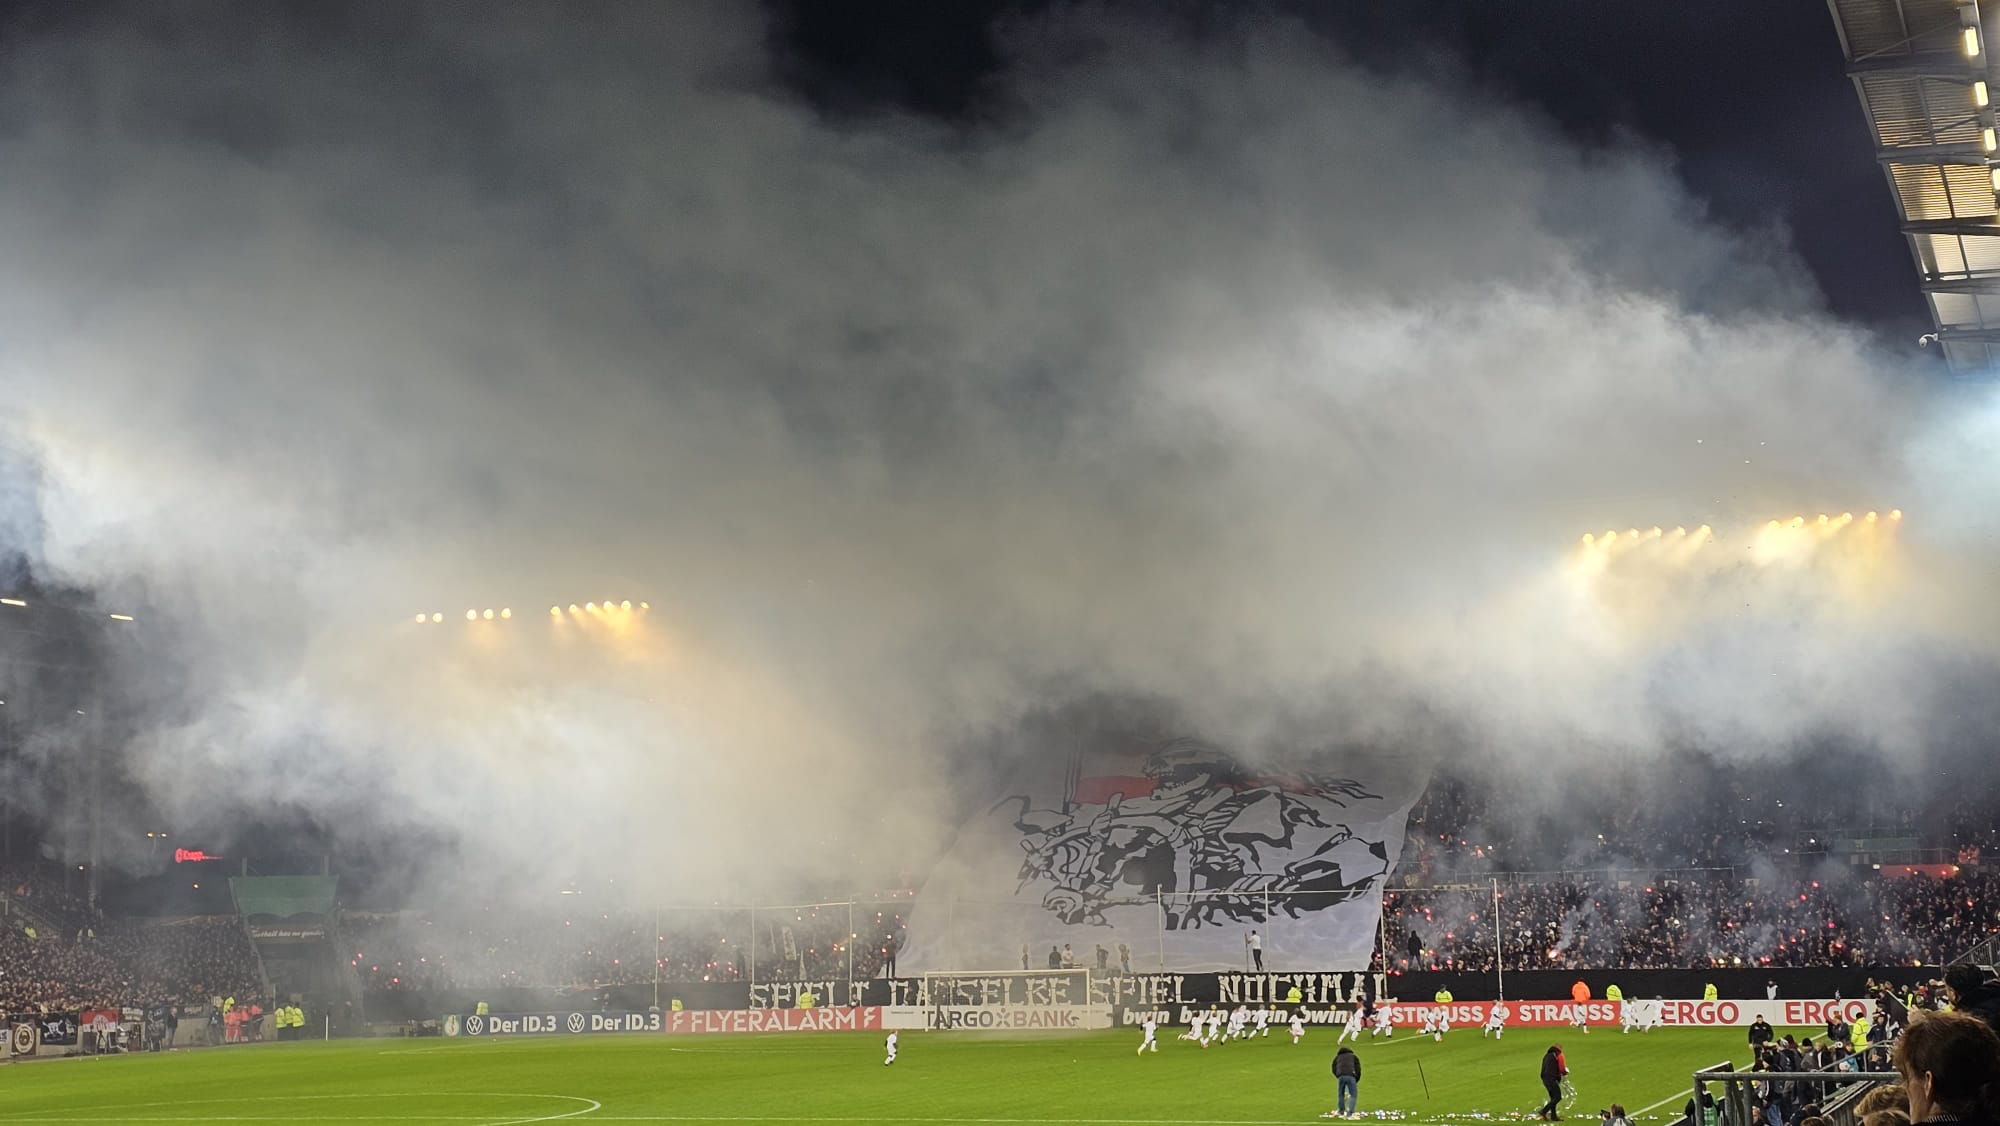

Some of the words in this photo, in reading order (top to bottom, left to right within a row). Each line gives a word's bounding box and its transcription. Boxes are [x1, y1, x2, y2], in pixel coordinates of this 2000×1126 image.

[1090, 974, 1197, 1005] SPIEL
[1218, 974, 1398, 1003] NOCHMAL
[591, 1014, 621, 1031] Der
[625, 1013, 660, 1031] ID.3
[691, 1009, 856, 1032] FLYERALARM
[1122, 1005, 1170, 1024] bwin
[1239, 1004, 1288, 1023] bin
[1392, 1005, 1484, 1023] STRAUSS
[1519, 1004, 1615, 1022] STRASS
[1661, 1001, 1739, 1024] ERGO
[1785, 1001, 1867, 1024] ERGO
[489, 1016, 519, 1033] Der
[522, 1015, 557, 1032] ID.3
